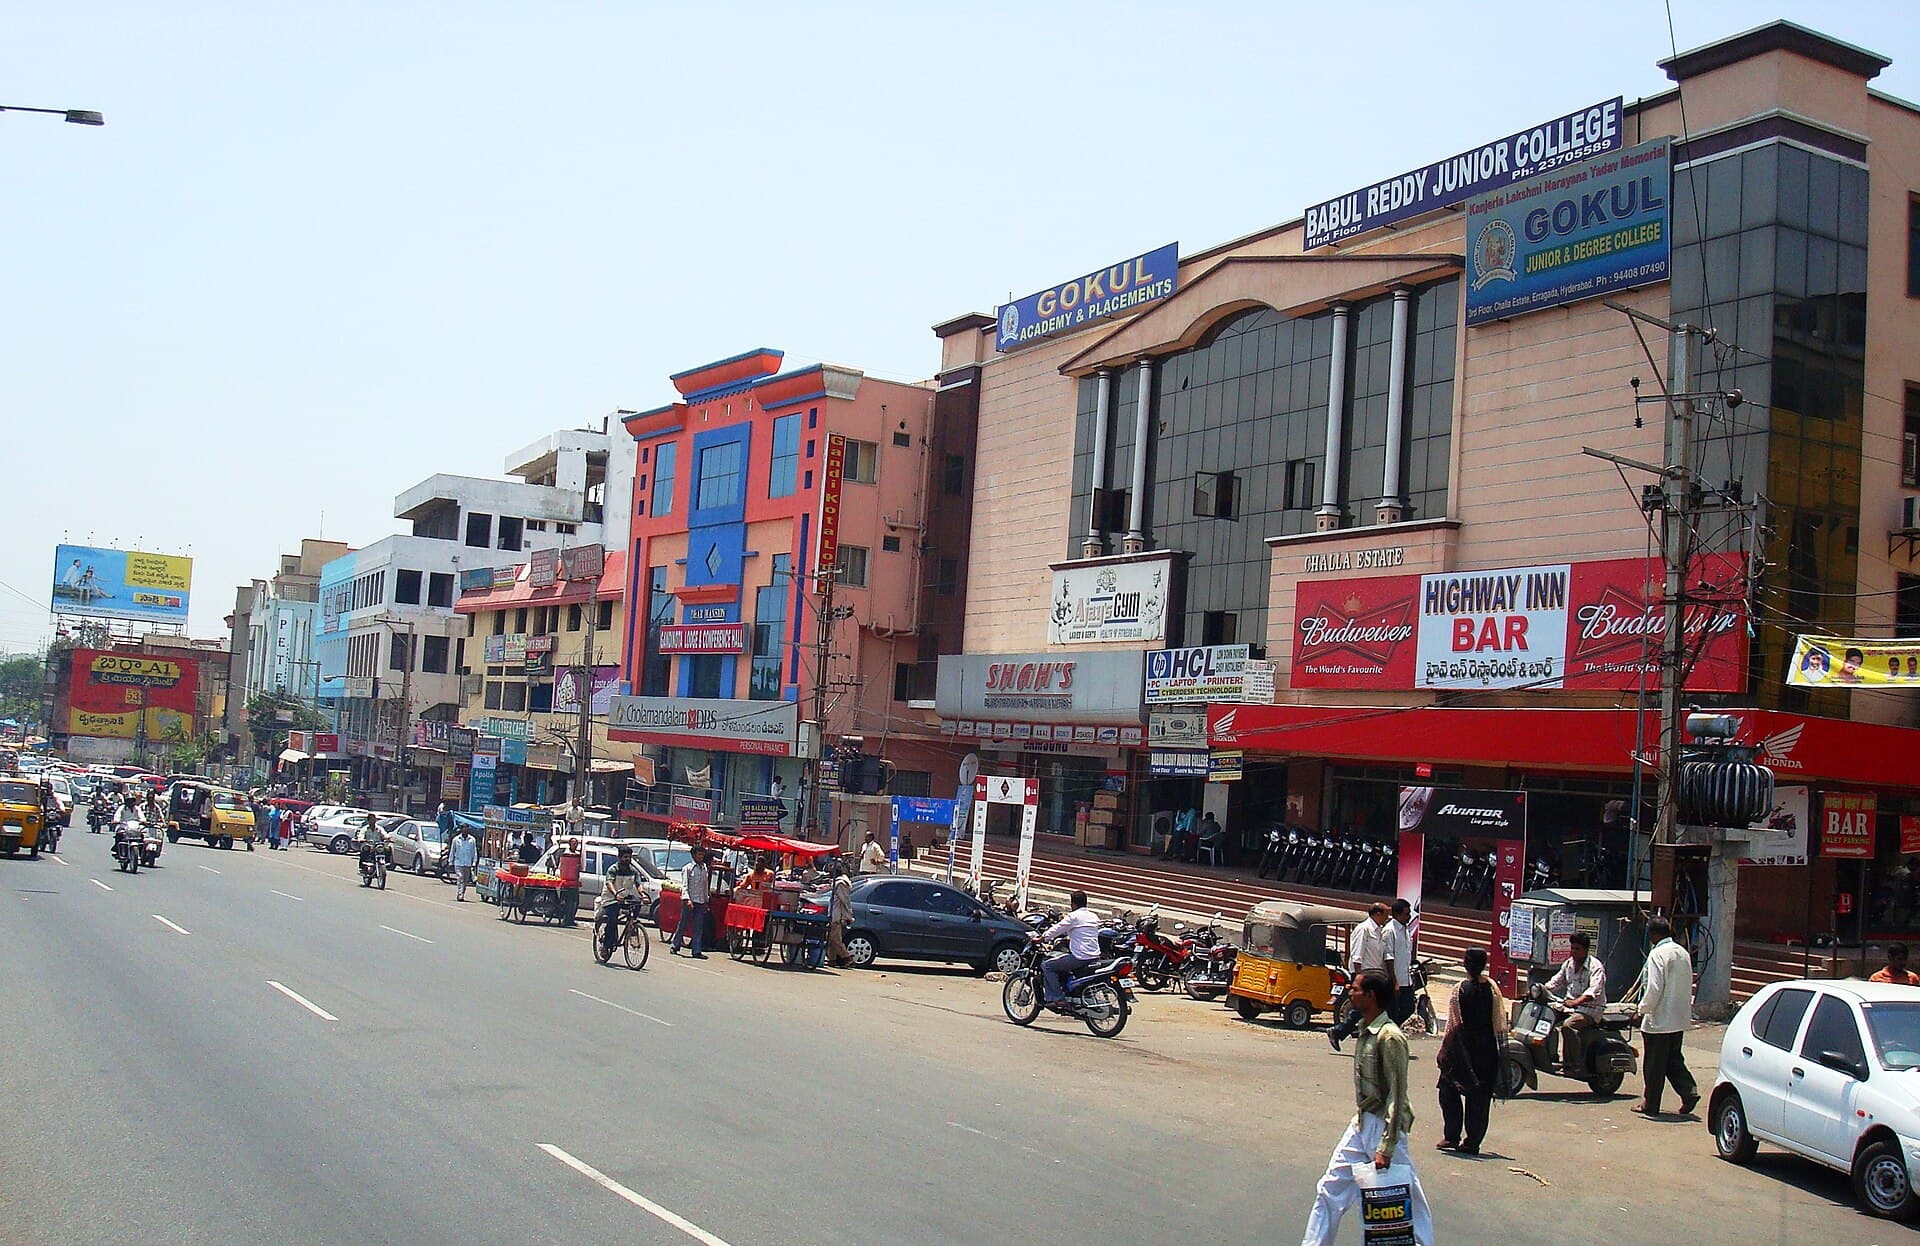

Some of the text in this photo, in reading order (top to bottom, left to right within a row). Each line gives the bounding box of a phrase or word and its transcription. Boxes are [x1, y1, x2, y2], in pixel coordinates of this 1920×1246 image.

[1306, 101, 1617, 239] BABUL REDDY JUNIOR COLLEGE
[1511, 139, 1612, 181] Ph: 23705589
[1590, 163, 1618, 180] Yadav
[1620, 144, 1666, 168] Memorial
[1524, 176, 1665, 244] GOKUL
[1333, 223, 1363, 239] Floor
[1526, 222, 1661, 274] JUNIOR & DEGREE COLLEGE
[1037, 257, 1153, 318] GOKUL
[1020, 278, 1172, 341] ACADEMY & PLACEMENTS
[1304, 547, 1403, 573] CHALLA ESTATE
[1425, 571, 1566, 616] HIGHWAY INN
[731, 628, 743, 648] HALL
[1300, 617, 1413, 646] Budweiser
[1452, 614, 1529, 653] BAR
[1172, 648, 1216, 679] HCL
[1305, 664, 1383, 674] The World's Favourite
[1151, 680, 1161, 688] PC
[1169, 678, 1197, 687] LAPTOP
[1161, 686, 1243, 696] CYBERDESK TECHNOLOGIES
[626, 703, 718, 730] Cholamandalam DBS
[739, 741, 785, 753] PERSONAL FINANCE
[474, 770, 494, 779] Apollo
[1763, 757, 1804, 769] HONDA
[1437, 804, 1504, 819] AVIATOR
[1495, 819, 1509, 828] style
[1826, 811, 1869, 836] BAR
[1365, 1202, 1405, 1220] Jeans
